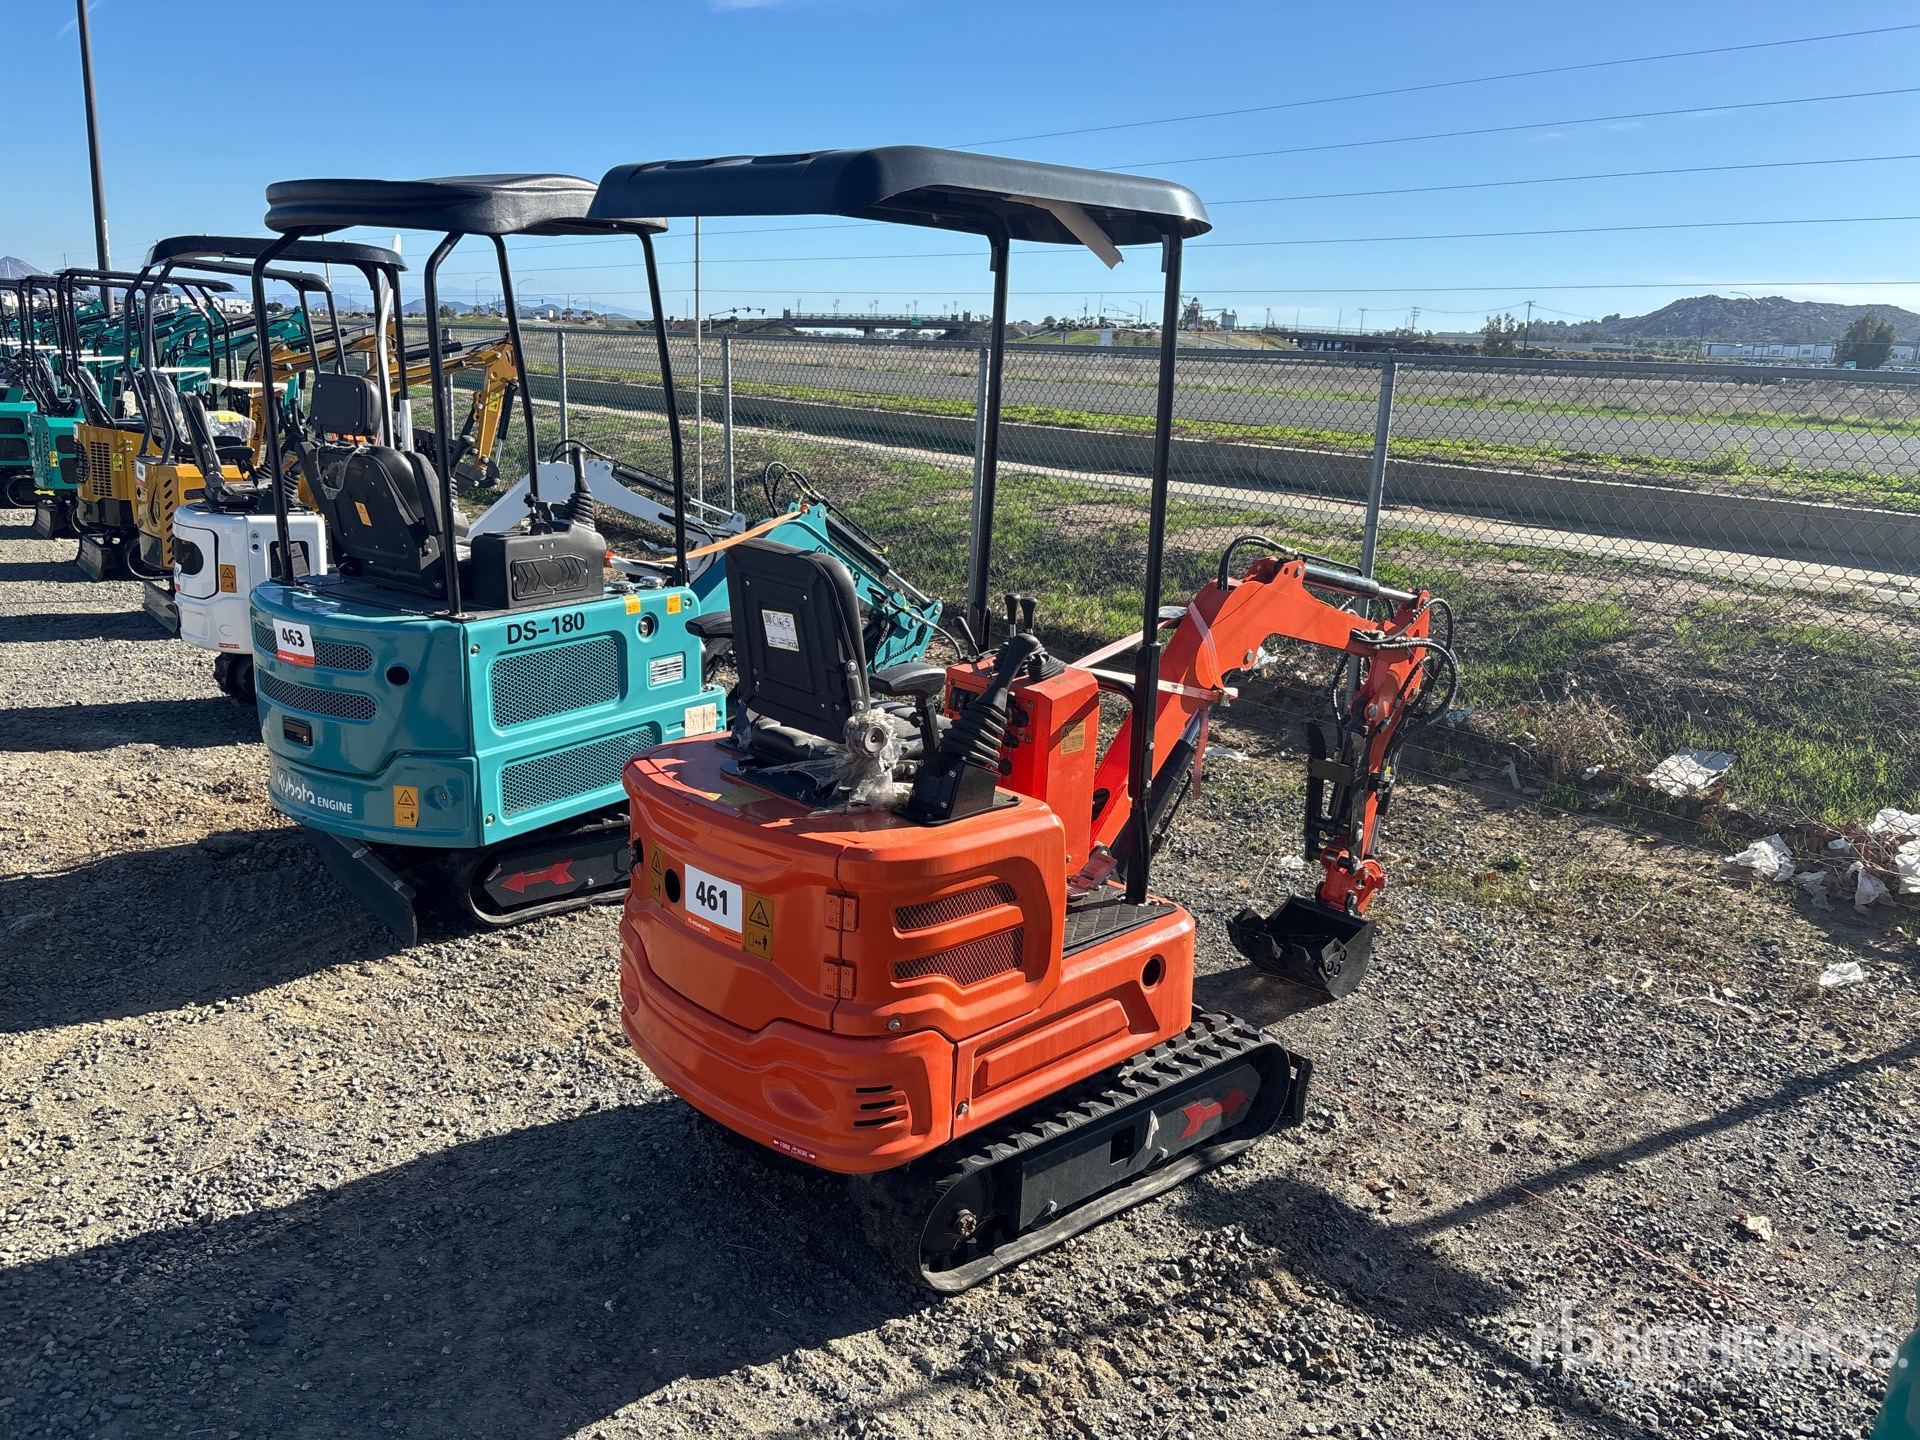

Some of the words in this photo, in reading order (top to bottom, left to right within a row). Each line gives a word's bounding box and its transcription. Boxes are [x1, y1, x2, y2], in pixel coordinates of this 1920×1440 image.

[282, 627, 305, 648] 463
[507, 611, 585, 645] DS-180
[277, 771, 315, 805] Kubota
[317, 797, 353, 813] ENGINE
[695, 880, 728, 916] 461
